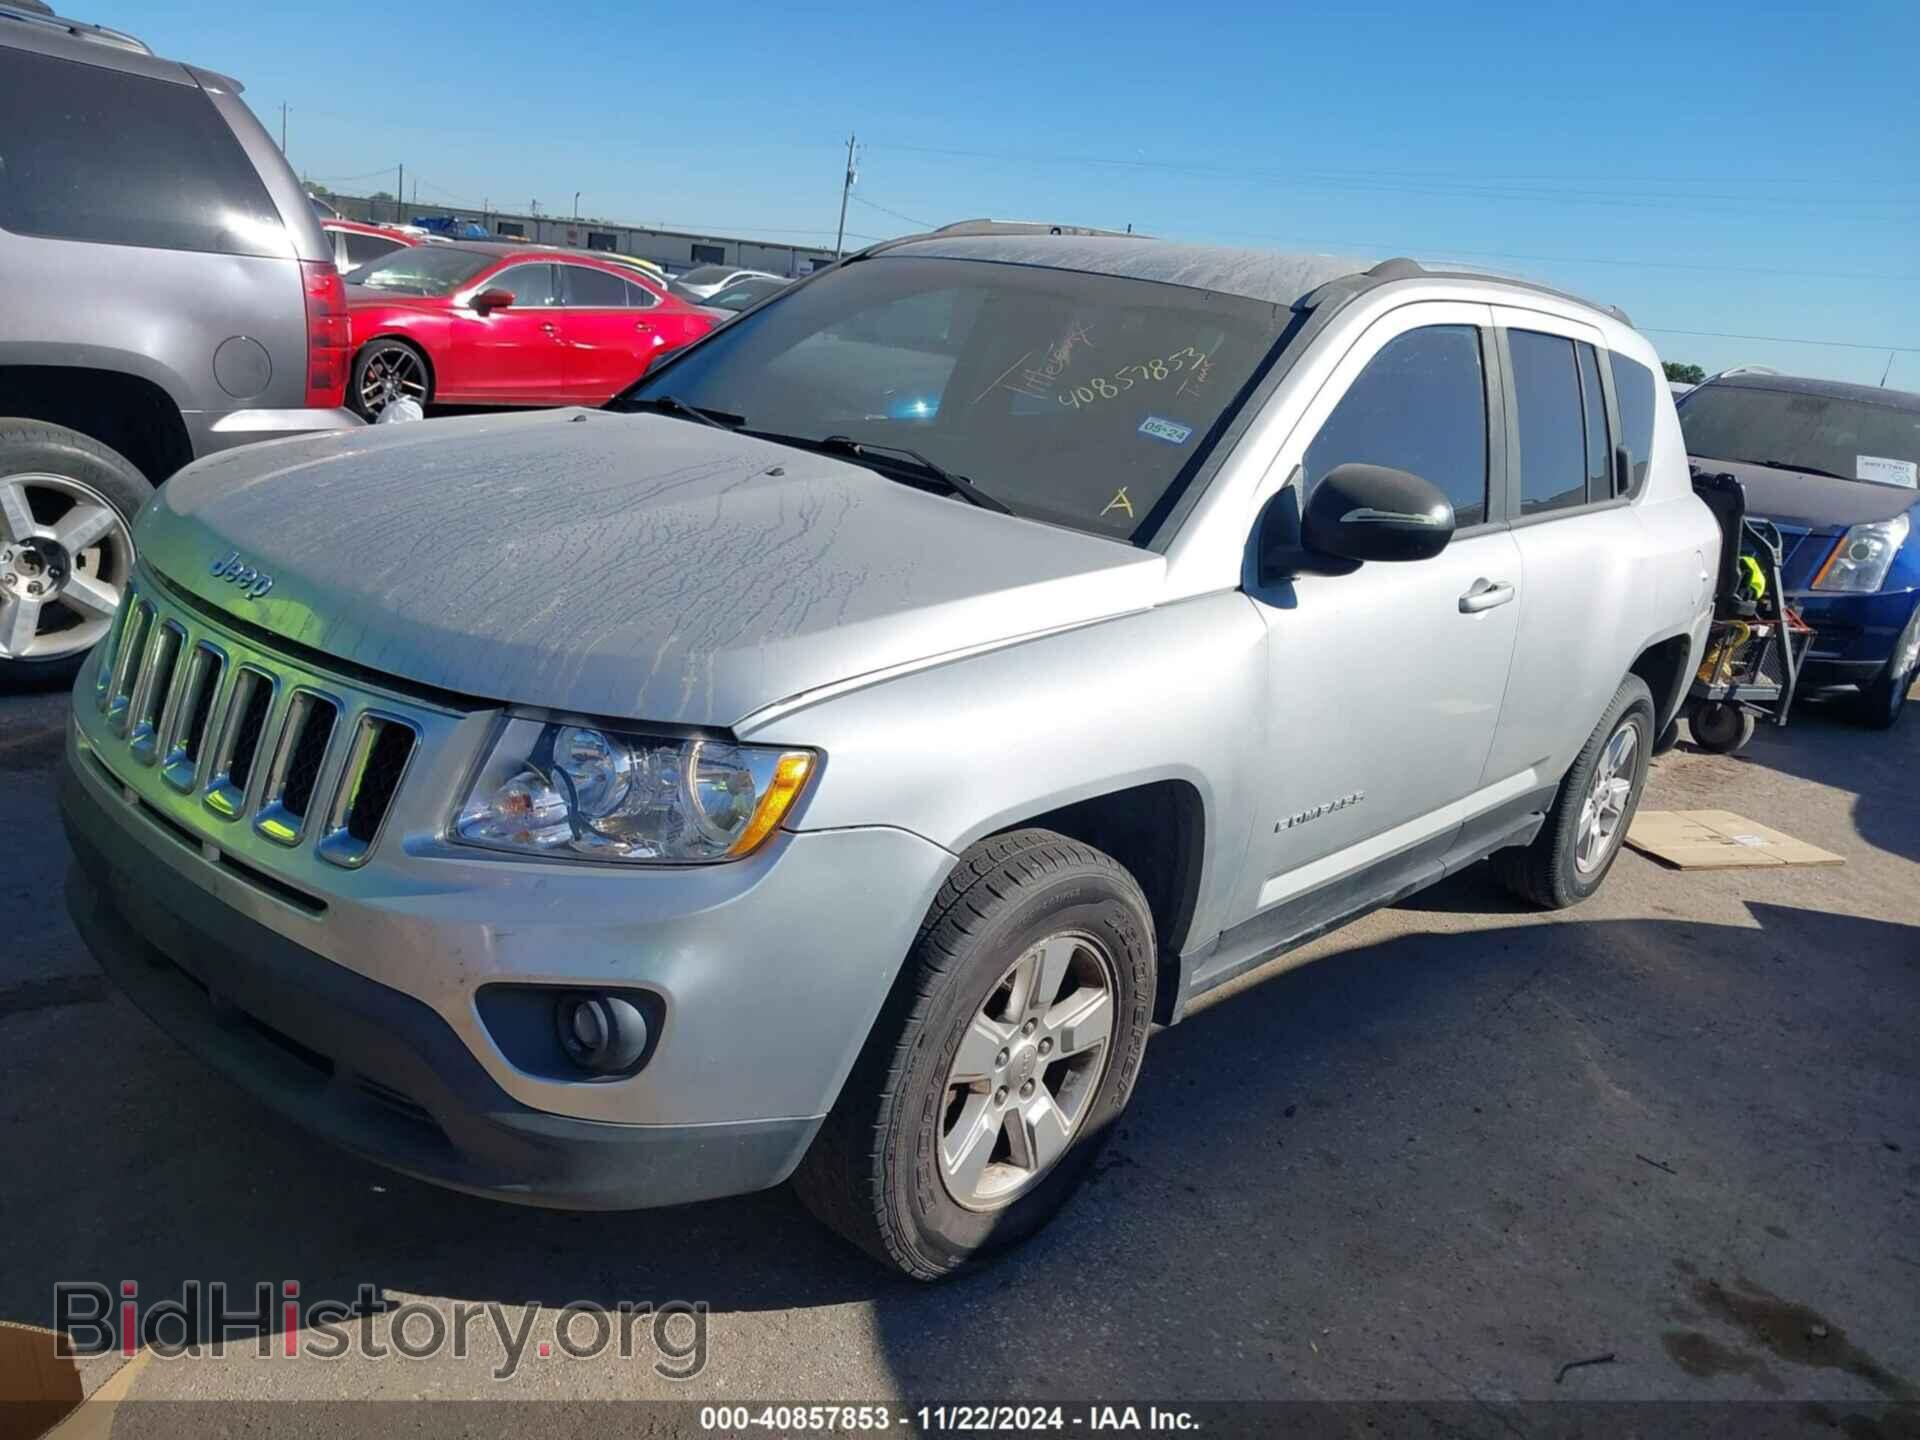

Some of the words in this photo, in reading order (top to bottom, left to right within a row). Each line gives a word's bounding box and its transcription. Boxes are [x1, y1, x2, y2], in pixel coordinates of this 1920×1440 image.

[1058, 347, 1205, 408] 40857853
[1144, 421, 1187, 440] 05-24
[1100, 486, 1133, 518] A
[208, 551, 273, 600] Jeep
